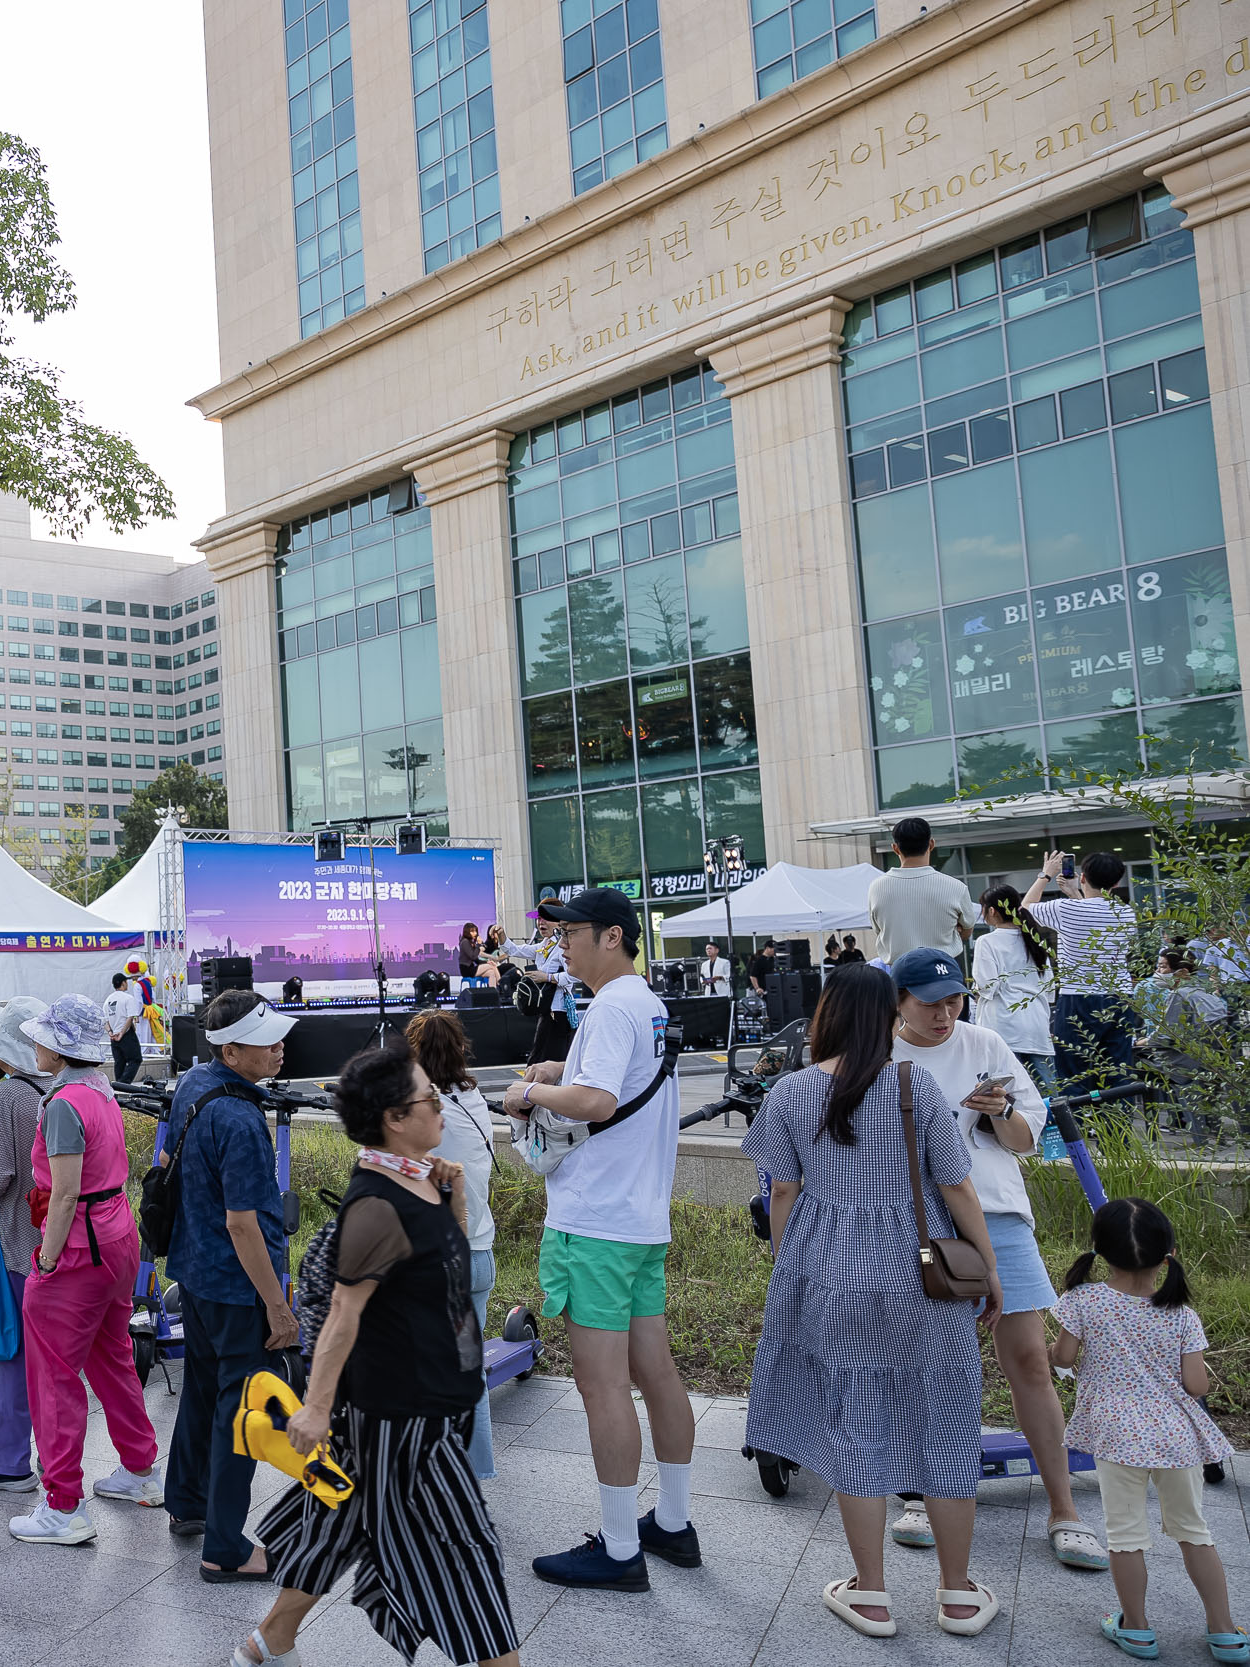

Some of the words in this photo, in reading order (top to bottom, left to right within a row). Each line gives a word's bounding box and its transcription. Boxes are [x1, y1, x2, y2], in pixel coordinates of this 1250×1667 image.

[486, 276, 577, 343] 구하라
[591, 220, 693, 297] 그러면
[710, 176, 786, 240] 주실
[807, 112, 941, 201] 것이요
[520, 344, 573, 381] Ask,
[583, 312, 629, 352] and
[637, 303, 659, 331] it
[672, 269, 728, 314] will
[734, 260, 769, 289] be
[779, 215, 883, 277] given.
[890, 149, 1027, 222] Knock,
[1035, 99, 1117, 161] and
[1128, 68, 1206, 117] the
[1003, 600, 1047, 625] BIG
[1054, 583, 1126, 614] BEAR
[1137, 571, 1162, 601] 8
[1018, 646, 1081, 665] PRMIUM
[1070, 645, 1165, 678] 레스토랑
[954, 672, 1012, 698] 패밀리
[279, 881, 311, 900] 2023
[315, 882, 344, 900] 군자
[348, 881, 418, 901] 한마당축제
[651, 874, 706, 896] 정형외과
[26, 935, 65, 948] 출연자
[72, 935, 110, 948] 대기실
